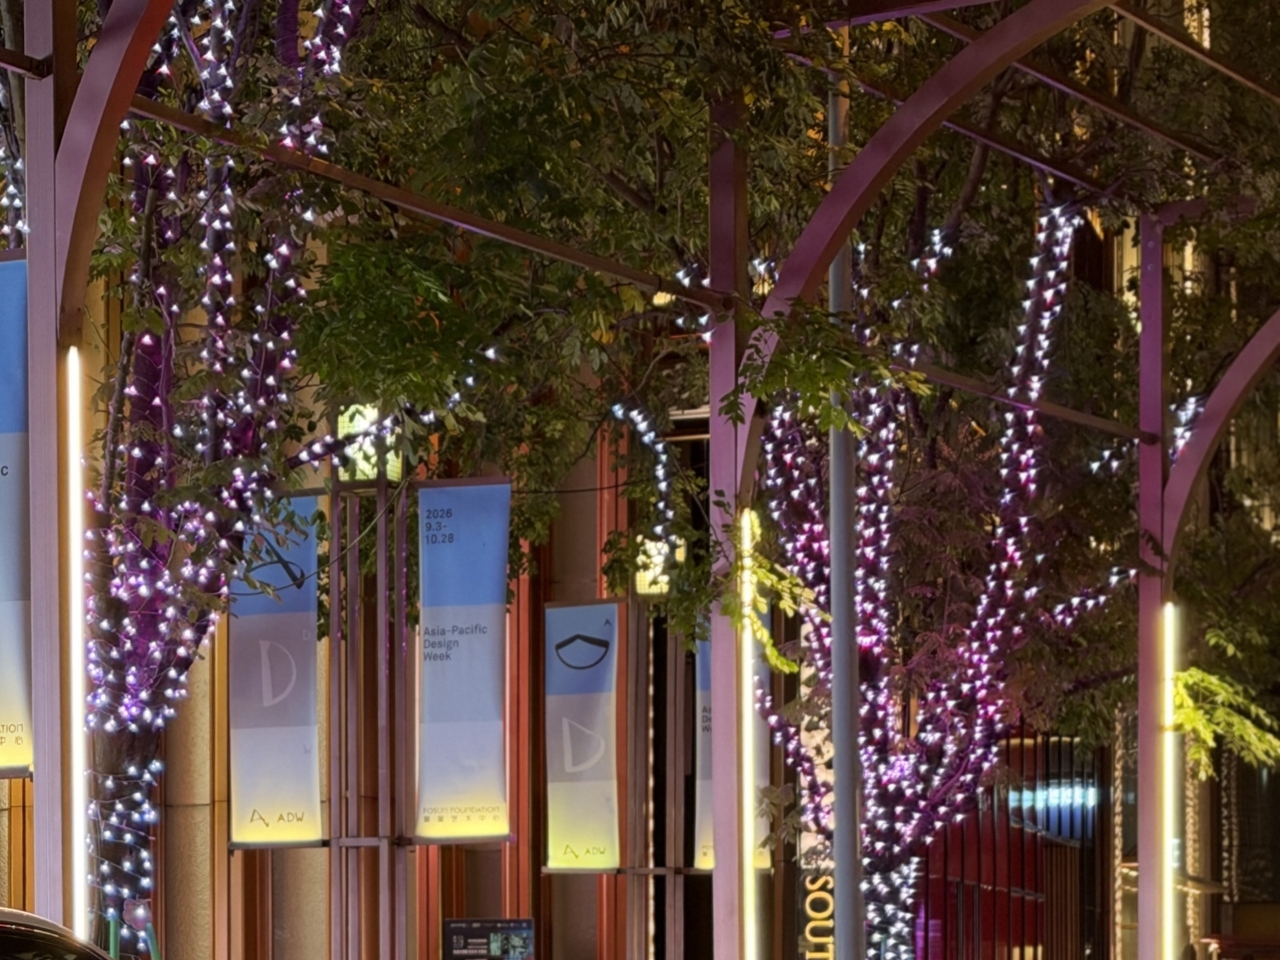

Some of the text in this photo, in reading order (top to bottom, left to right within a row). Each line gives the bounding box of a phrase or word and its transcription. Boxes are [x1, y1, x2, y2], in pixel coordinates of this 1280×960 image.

[425, 508, 453, 519] 2026
[425, 521, 448, 532] 9.3-
[425, 533, 454, 545] 10.28
[423, 623, 488, 637] Asia-Pacific
[424, 638, 460, 651] Design
[423, 651, 452, 661] Week
[277, 812, 305, 824] ADW
